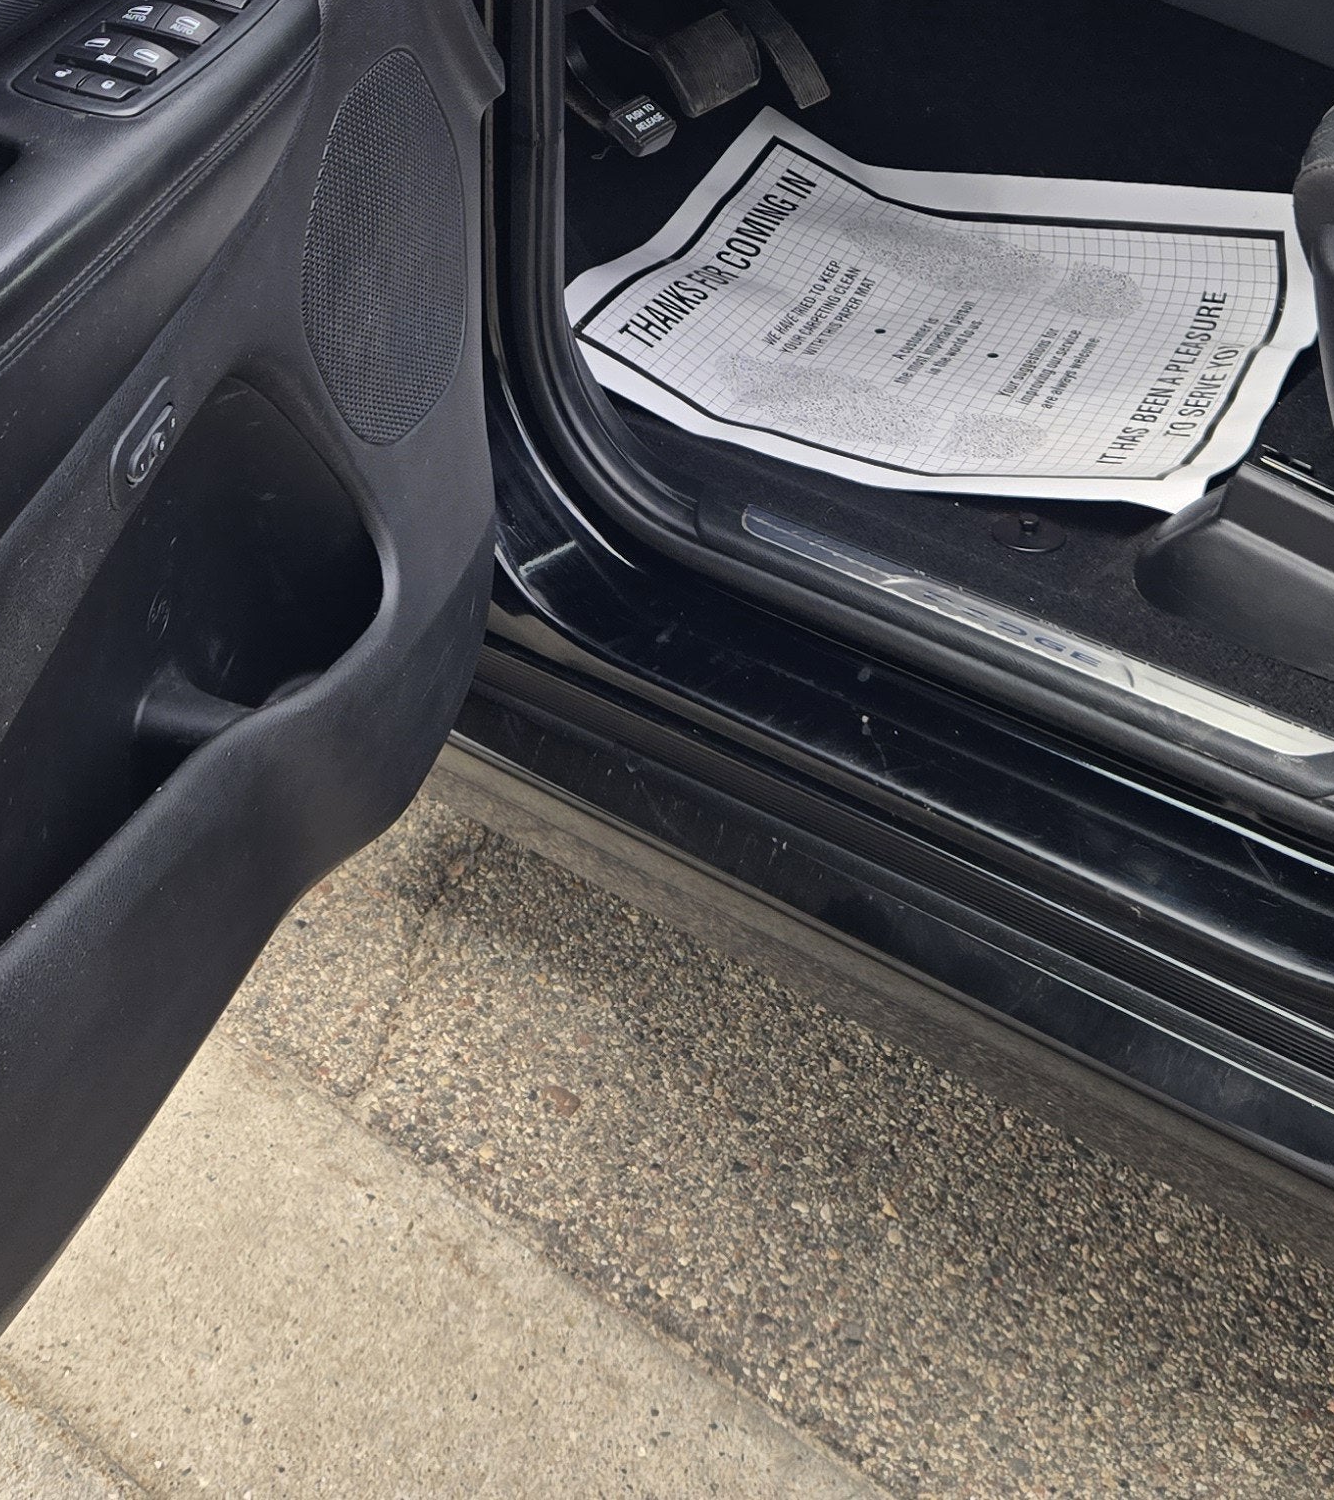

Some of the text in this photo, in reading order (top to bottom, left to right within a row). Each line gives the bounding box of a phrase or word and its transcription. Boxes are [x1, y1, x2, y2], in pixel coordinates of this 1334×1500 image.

[122, 13, 147, 22] AUTO
[170, 24, 196, 35] AUTO
[625, 103, 655, 123] PUSH TO
[635, 112, 665, 132] RELEASE
[618, 168, 817, 348] THANKS FOR COMING IN
[762, 260, 841, 346] WE HAVE TRIED TO KEEP
[779, 266, 861, 354] YOUR CARPETING CLEAN
[802, 277, 876, 356] WITH THIS PAPER MAT
[894, 301, 976, 384] the most important person
[899, 324, 932, 353] customer
[945, 337, 968, 356] world
[996, 328, 1059, 397] Your suggestions for
[1015, 329, 1081, 405] improving our service
[1096, 291, 1227, 465] IT HAS BEEN A PLEASURE
[1041, 396, 1058, 409] are
[1051, 370, 1077, 395] always
[1178, 373, 1227, 417] SERVE
[1162, 421, 1197, 438] TO
